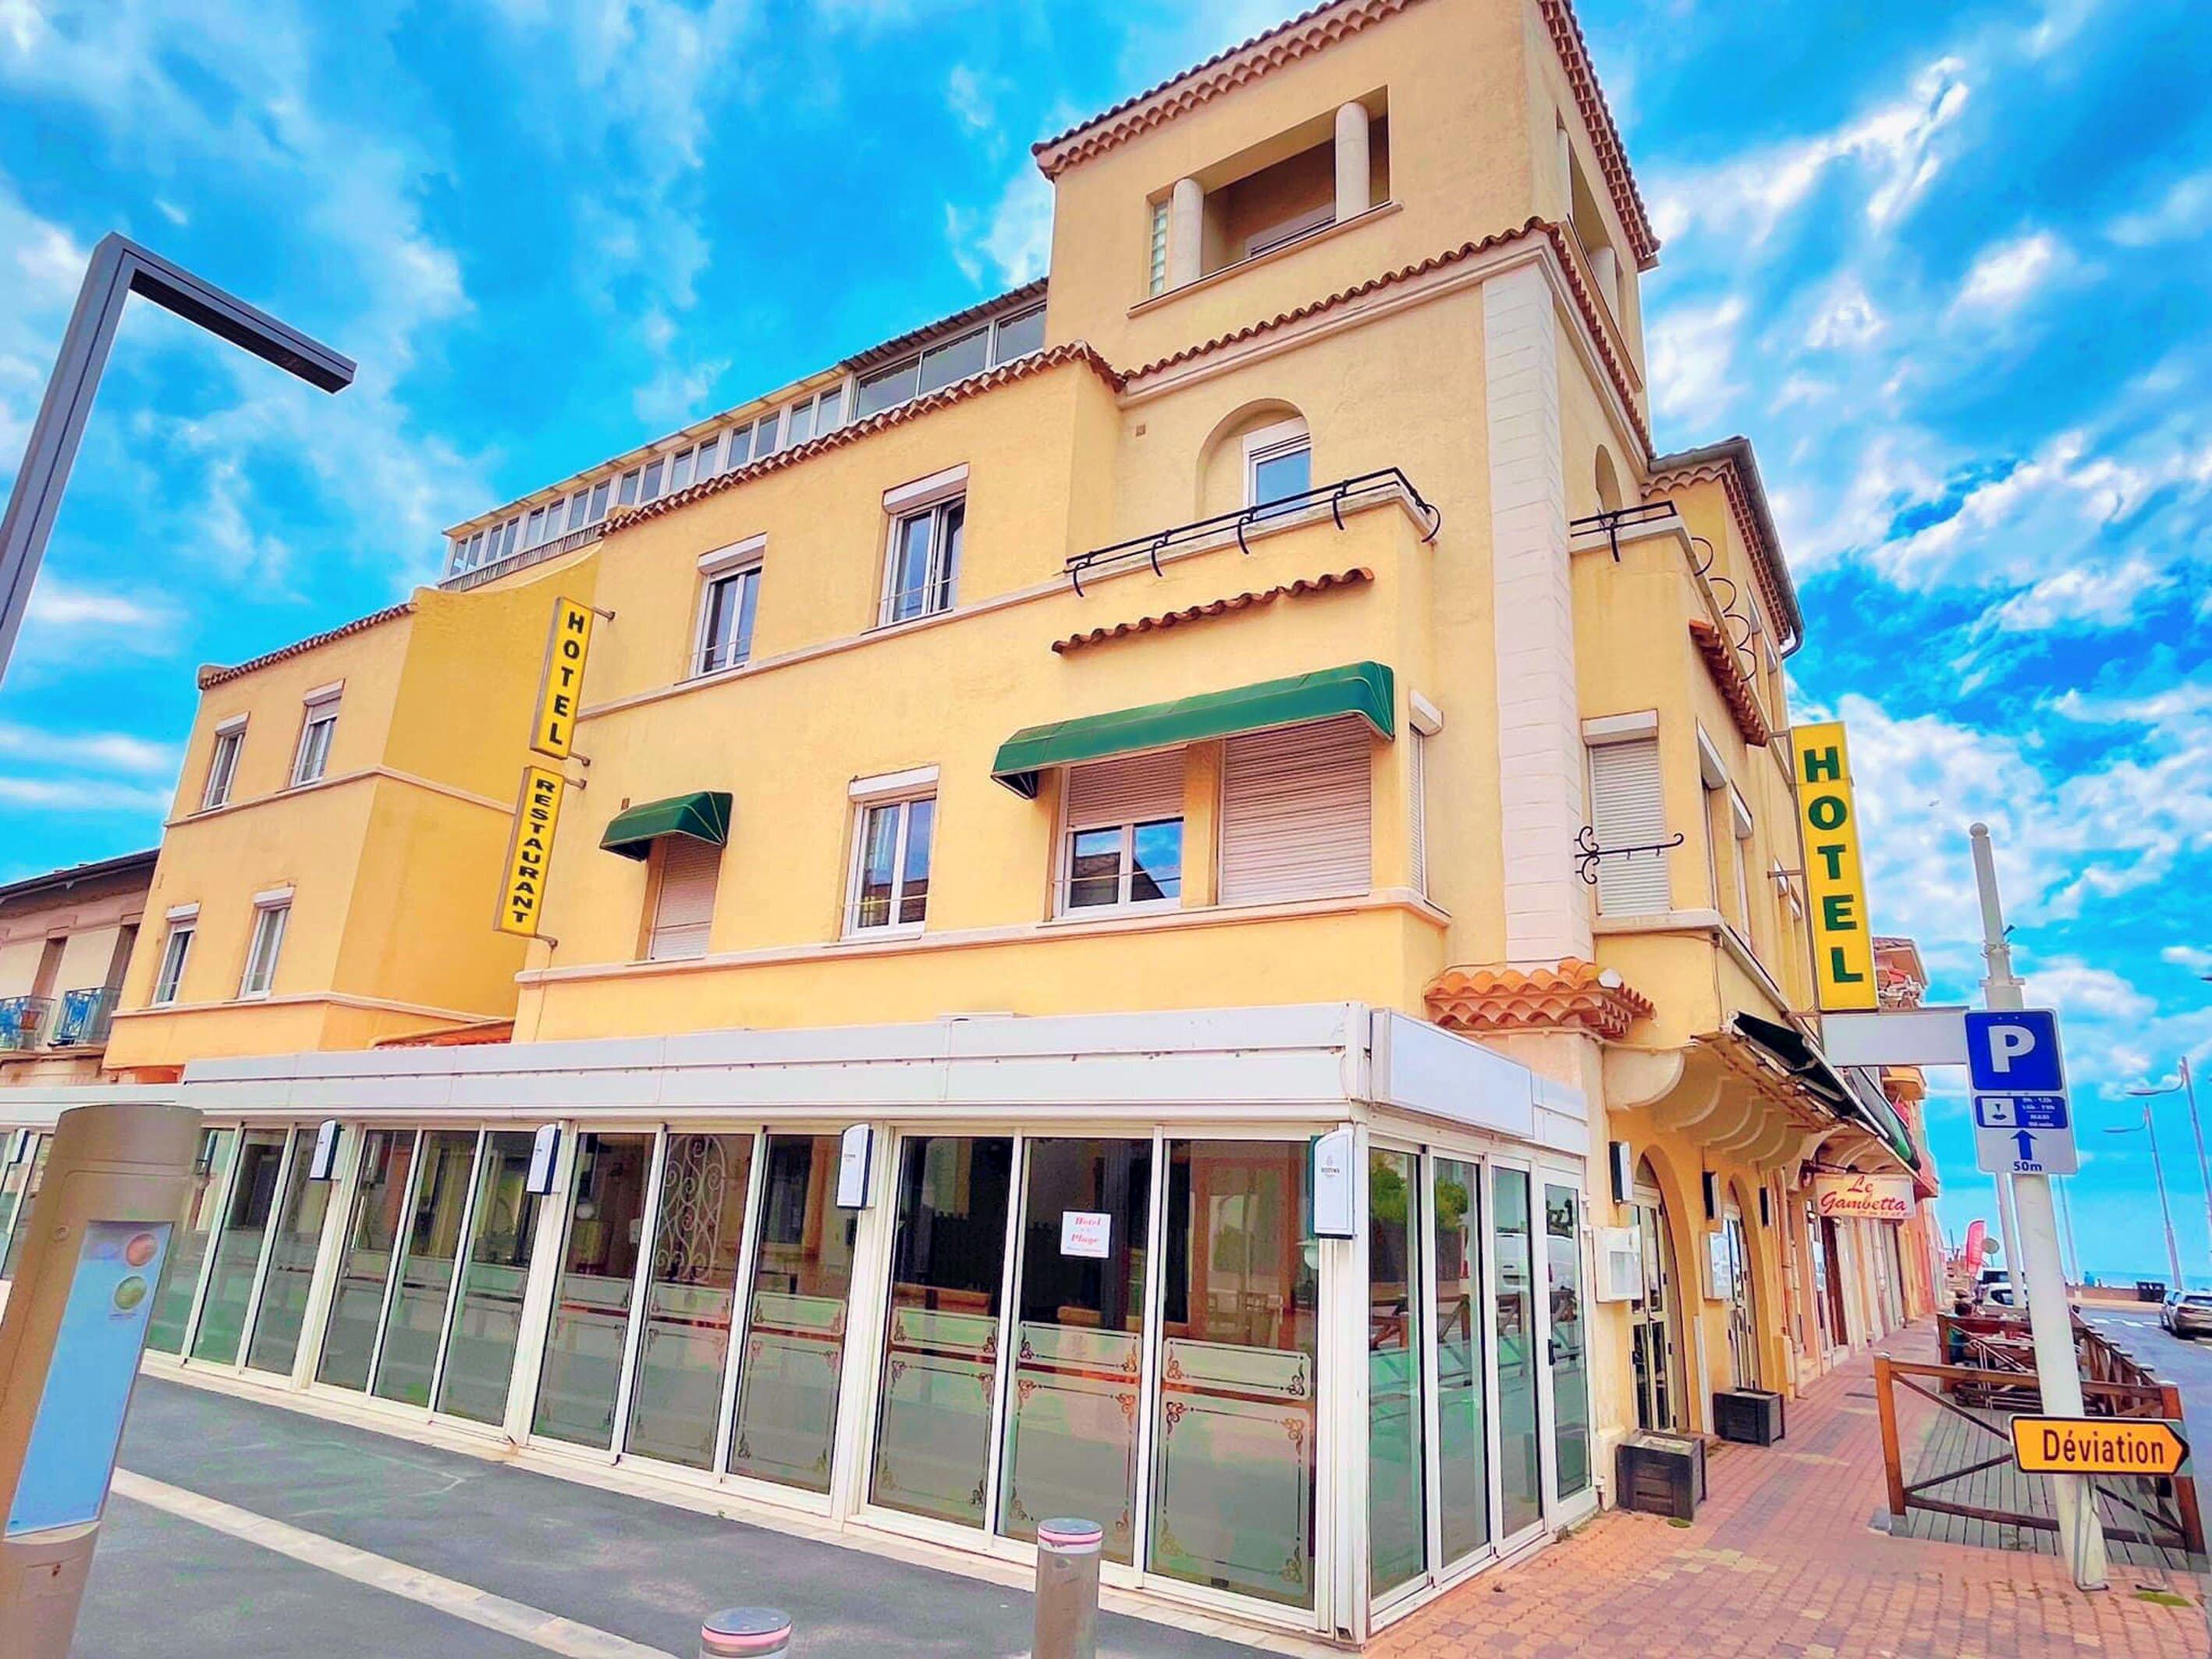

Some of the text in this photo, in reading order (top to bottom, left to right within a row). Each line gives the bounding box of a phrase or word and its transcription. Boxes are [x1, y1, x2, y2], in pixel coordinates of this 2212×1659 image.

[548, 610, 584, 746] HOTEL
[511, 777, 556, 924] RESTAURANT
[1803, 746, 1864, 983] HOTEL
[1987, 1025, 2036, 1072] P
[1847, 1174, 1873, 1193] Le
[2013, 1160, 2043, 1172] 50m
[1820, 1191, 1907, 1214] Gambetta
[2043, 1429, 2164, 1465] Déviation
